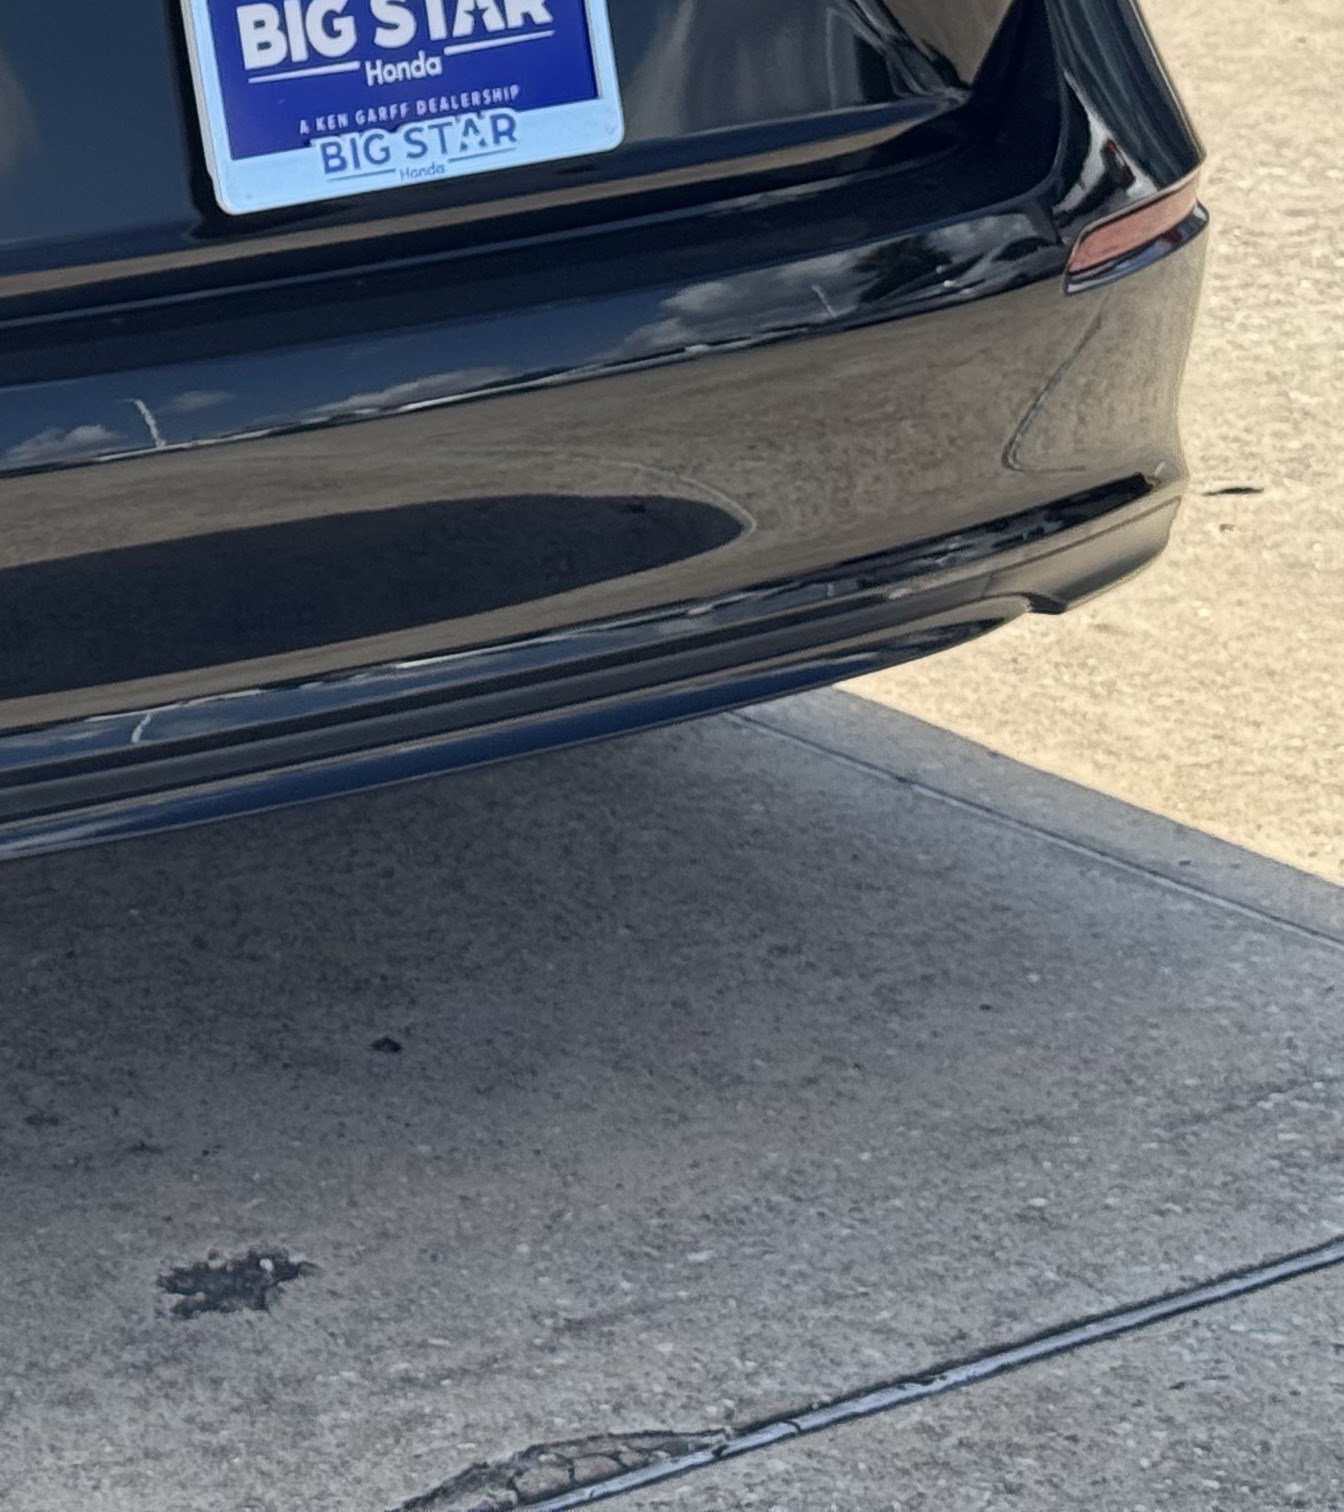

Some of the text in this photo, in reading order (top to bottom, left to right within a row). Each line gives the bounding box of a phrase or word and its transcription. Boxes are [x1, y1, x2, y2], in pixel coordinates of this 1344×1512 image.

[365, 50, 443, 87] Honda
[299, 84, 520, 135] A KEN GARFF DEALERSHIP
[319, 112, 518, 174] BIG STAR
[399, 161, 446, 182] Honda
